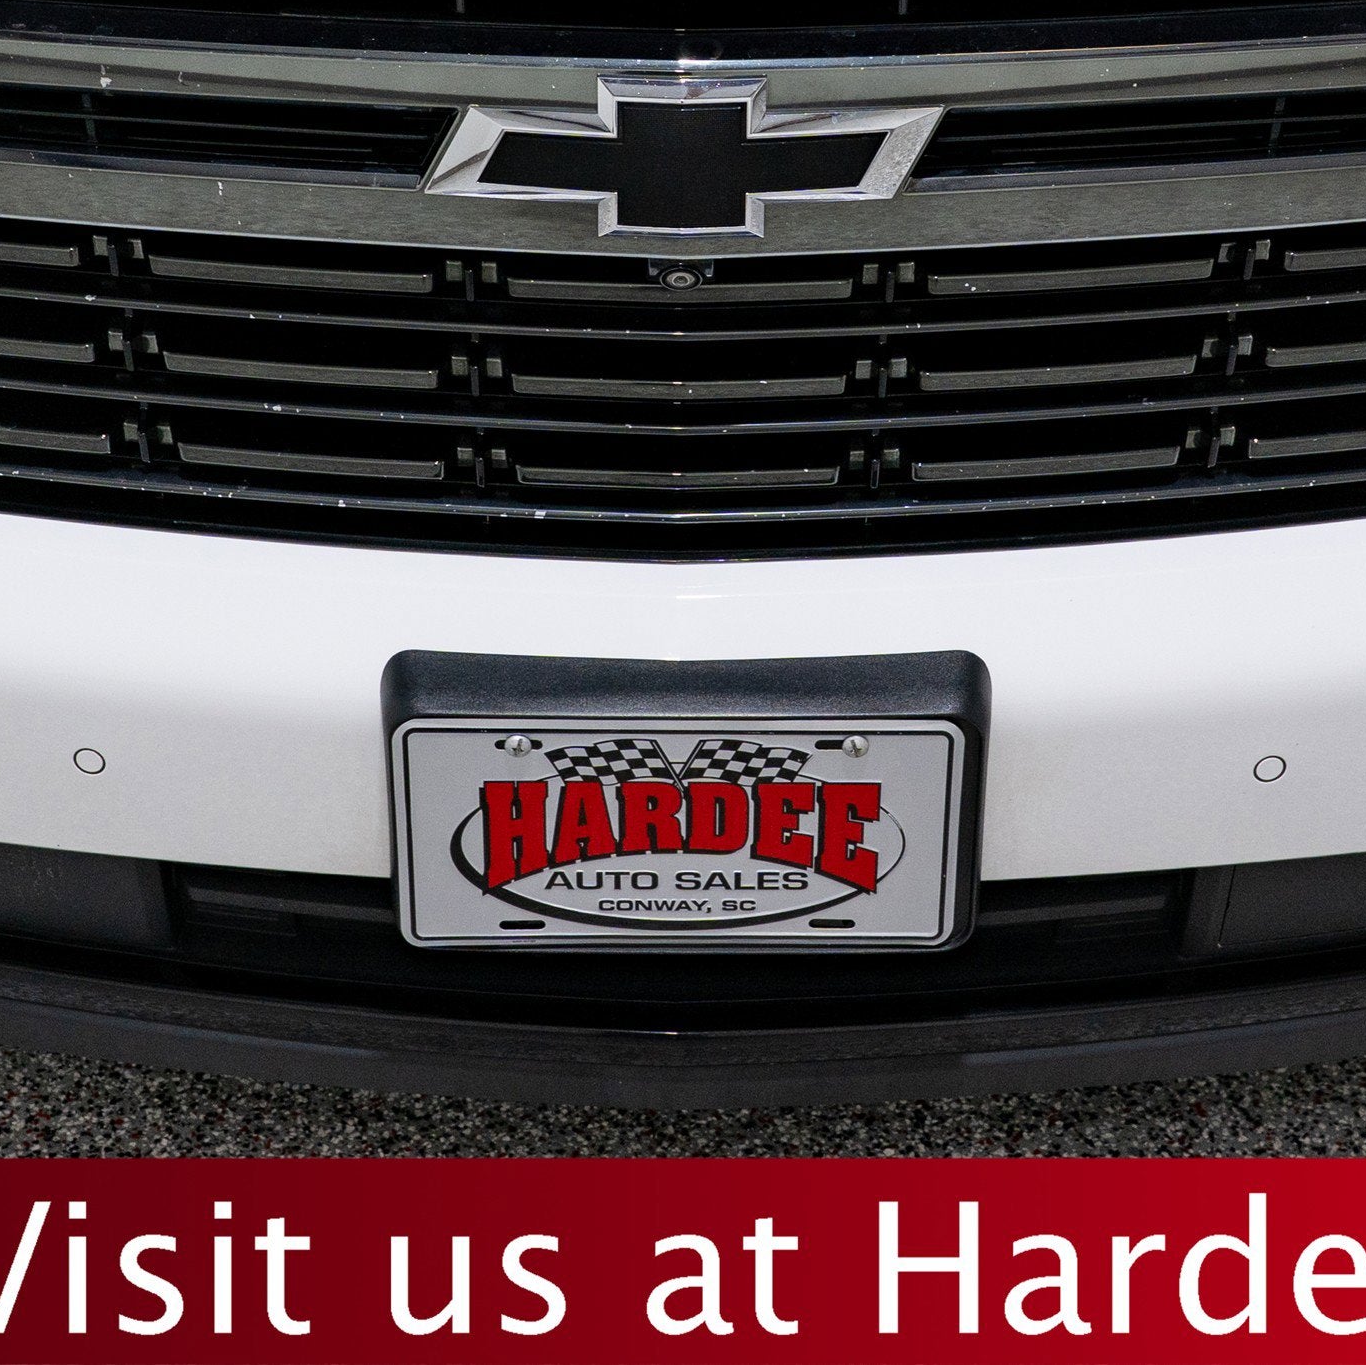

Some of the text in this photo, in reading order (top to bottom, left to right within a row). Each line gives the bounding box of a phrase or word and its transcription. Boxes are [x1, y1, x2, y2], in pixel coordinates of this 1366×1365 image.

[480, 780, 882, 894] HARDEE
[543, 870, 810, 891] AUTO SALES
[598, 899, 757, 914] CONWAY, SC
